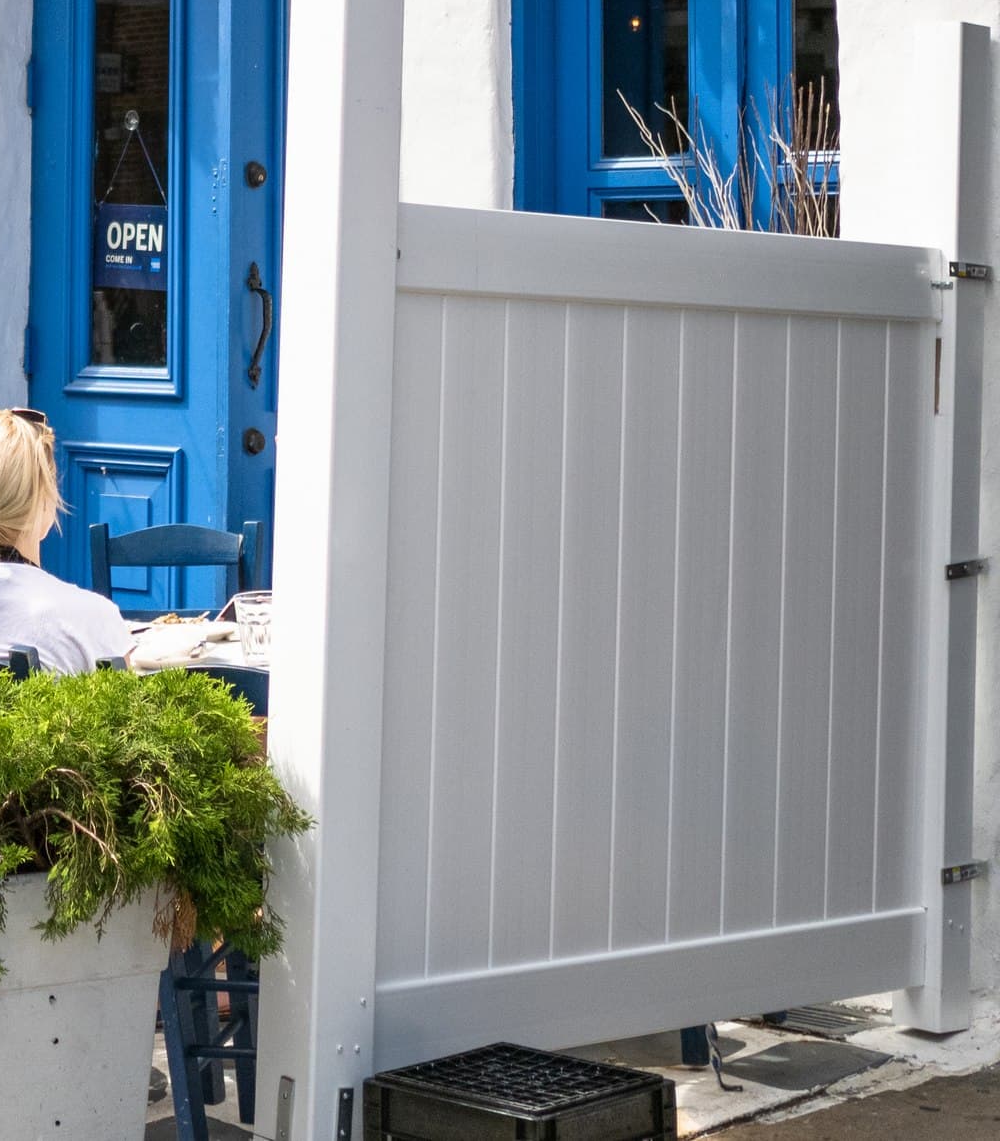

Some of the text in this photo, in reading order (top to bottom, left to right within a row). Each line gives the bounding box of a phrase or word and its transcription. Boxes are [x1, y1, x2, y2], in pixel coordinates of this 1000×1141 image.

[106, 221, 163, 253] OPEN
[105, 254, 133, 264] COME IN
